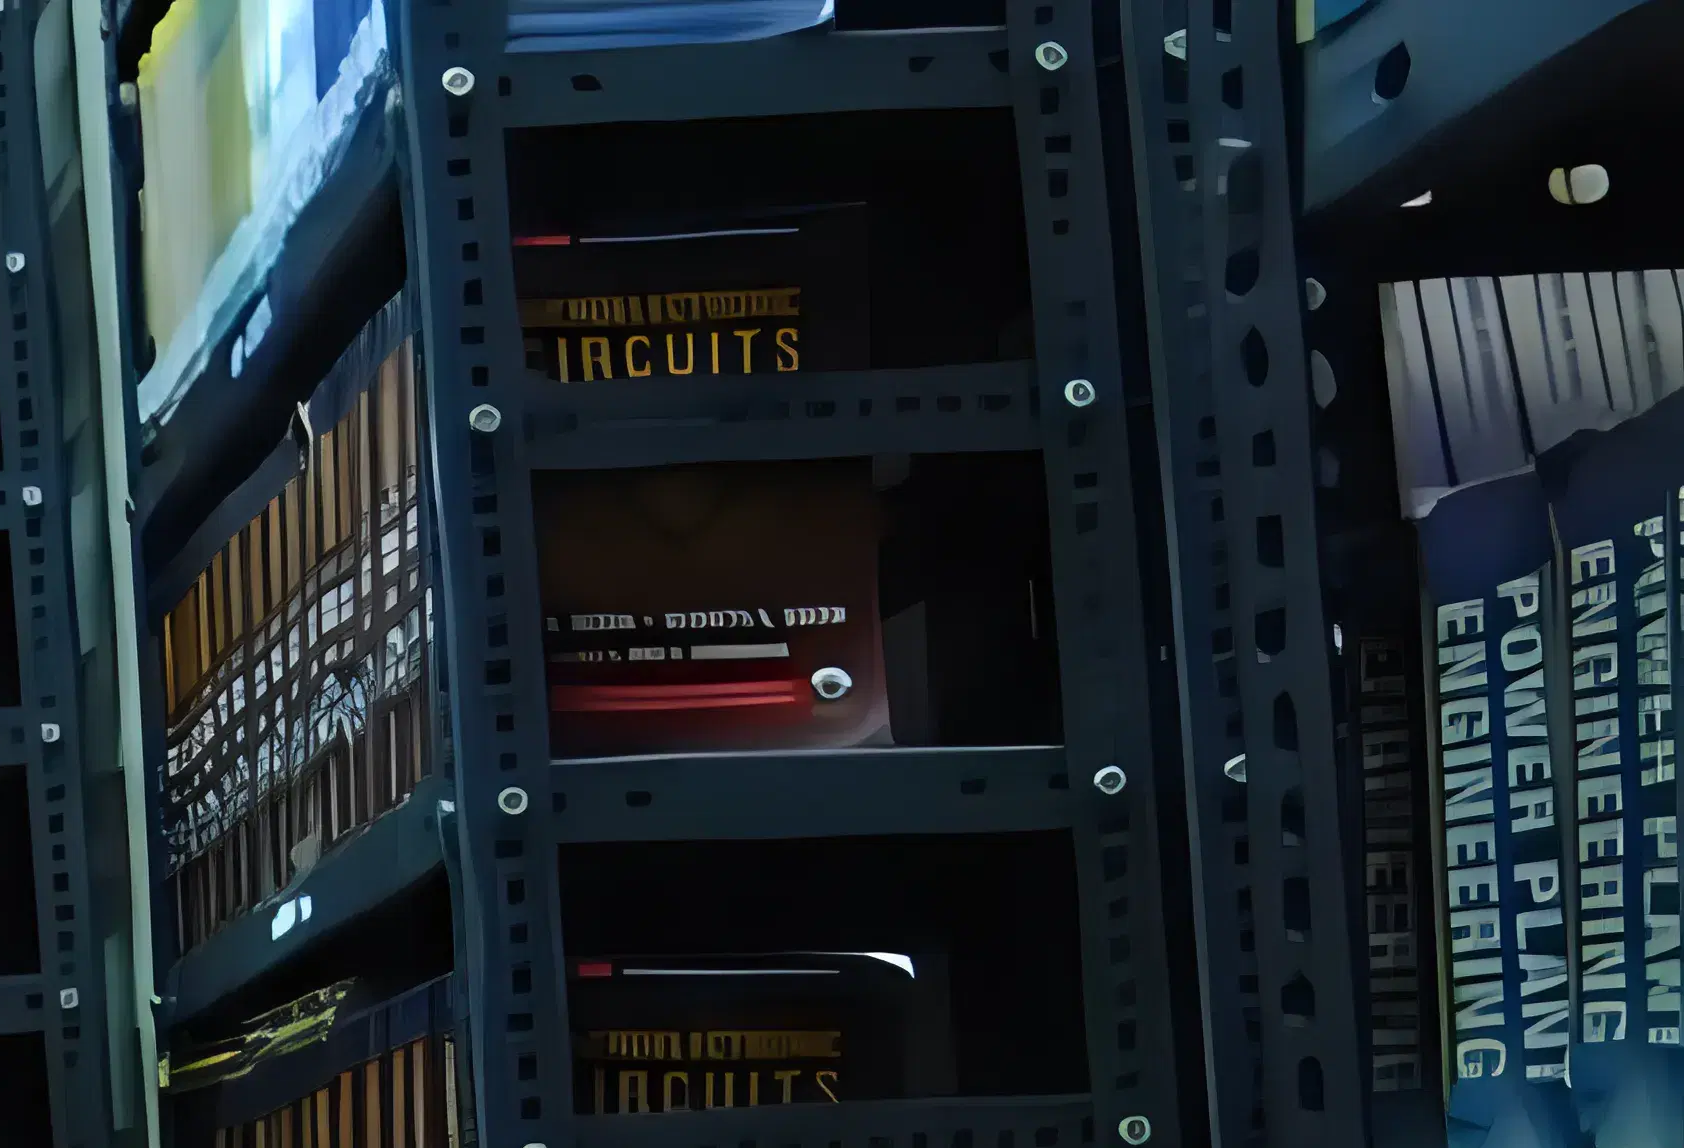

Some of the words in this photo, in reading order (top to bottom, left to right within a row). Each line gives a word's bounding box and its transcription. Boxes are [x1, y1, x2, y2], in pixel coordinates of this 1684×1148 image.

[556, 327, 800, 383] IRCUITS
[1496, 560, 1558, 834] POWER
[1570, 539, 1627, 1044] ENGINEERING
[1437, 598, 1508, 1081] ENGINEERING
[1512, 857, 1572, 1089] PLANT
